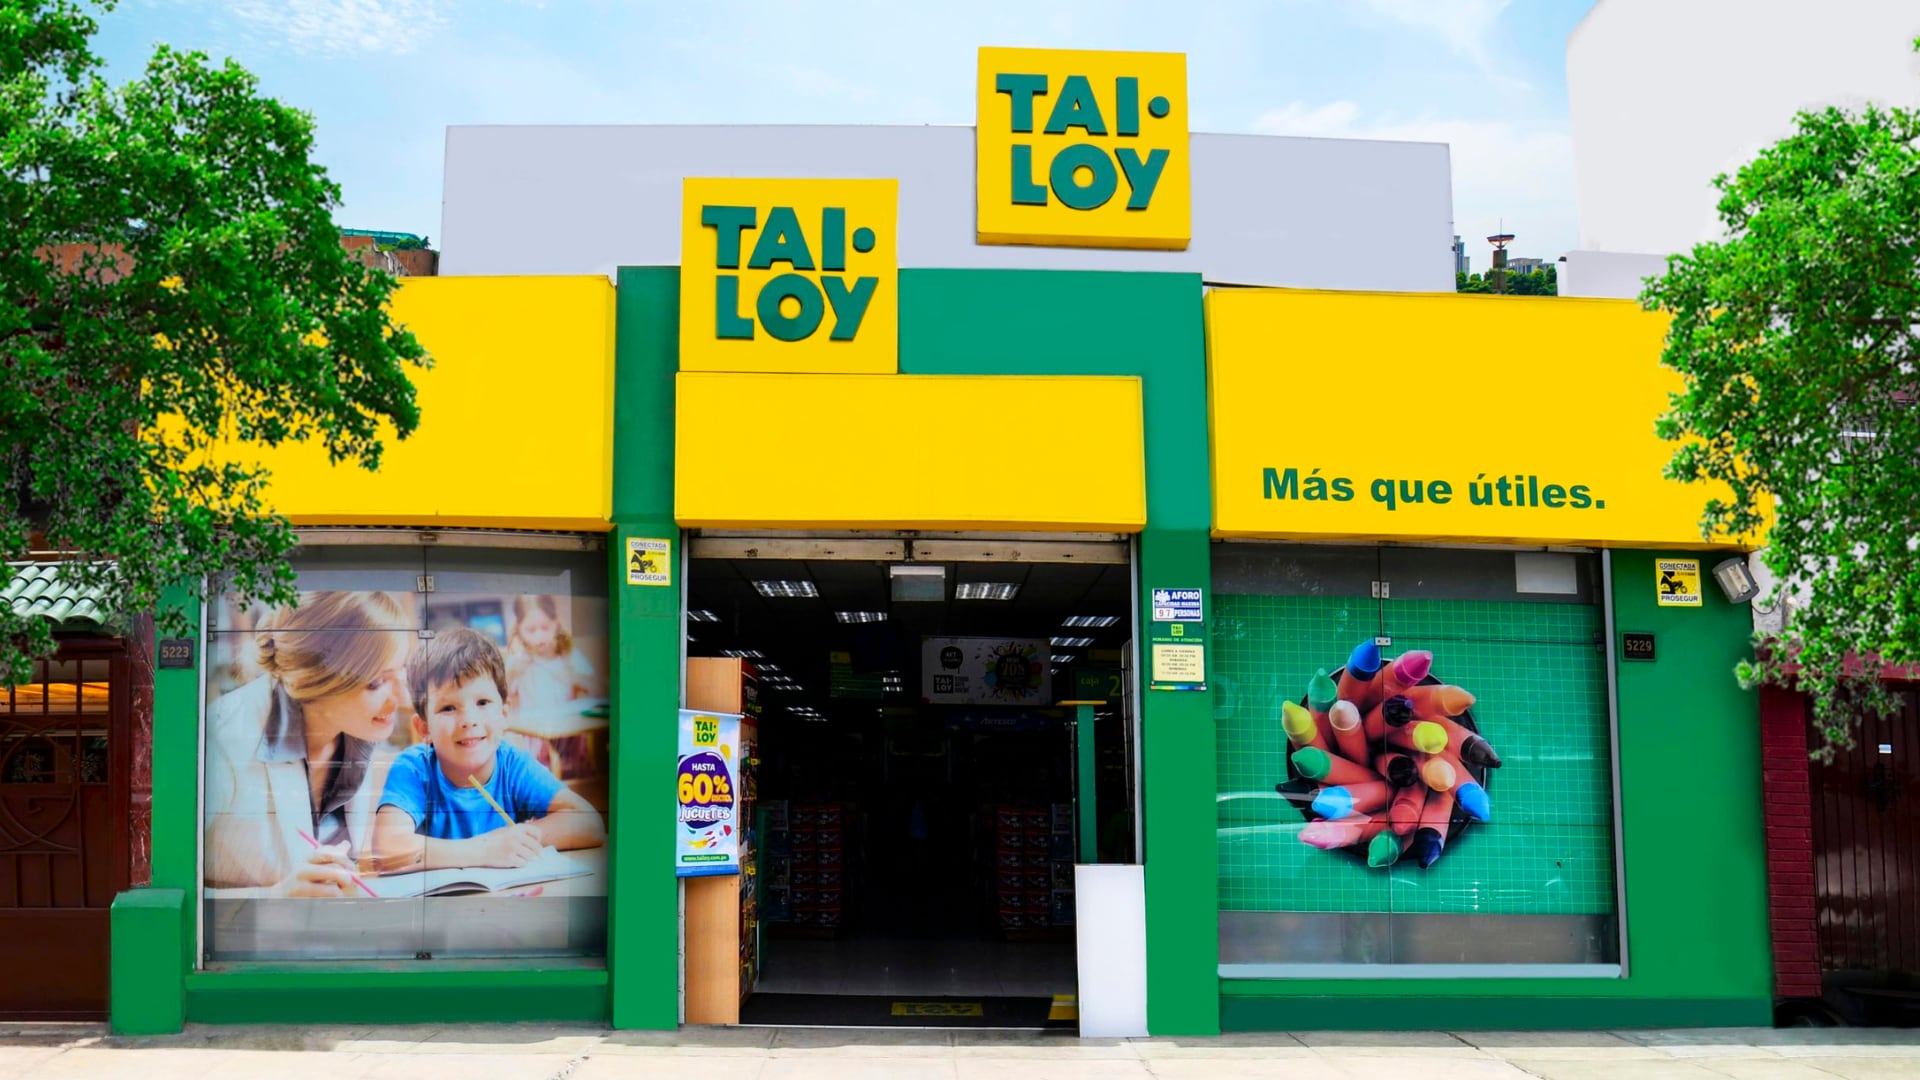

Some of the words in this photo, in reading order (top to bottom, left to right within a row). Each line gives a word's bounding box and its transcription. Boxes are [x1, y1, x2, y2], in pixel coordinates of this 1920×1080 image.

[1011, 143, 1171, 211] LOY
[715, 273, 880, 342] LOY
[1262, 467, 1355, 502] Más
[1370, 478, 1453, 511] que
[1468, 473, 1606, 509] útiles.
[630, 574, 667, 582] PROSEGUR
[1171, 591, 1200, 600] AFORO
[161, 646, 190, 658] 5223
[1625, 639, 1653, 652] 5229
[1108, 675, 1121, 697] 2
[696, 732, 716, 743] LOY
[691, 762, 716, 772] HASTA
[678, 772, 731, 805] 60%
